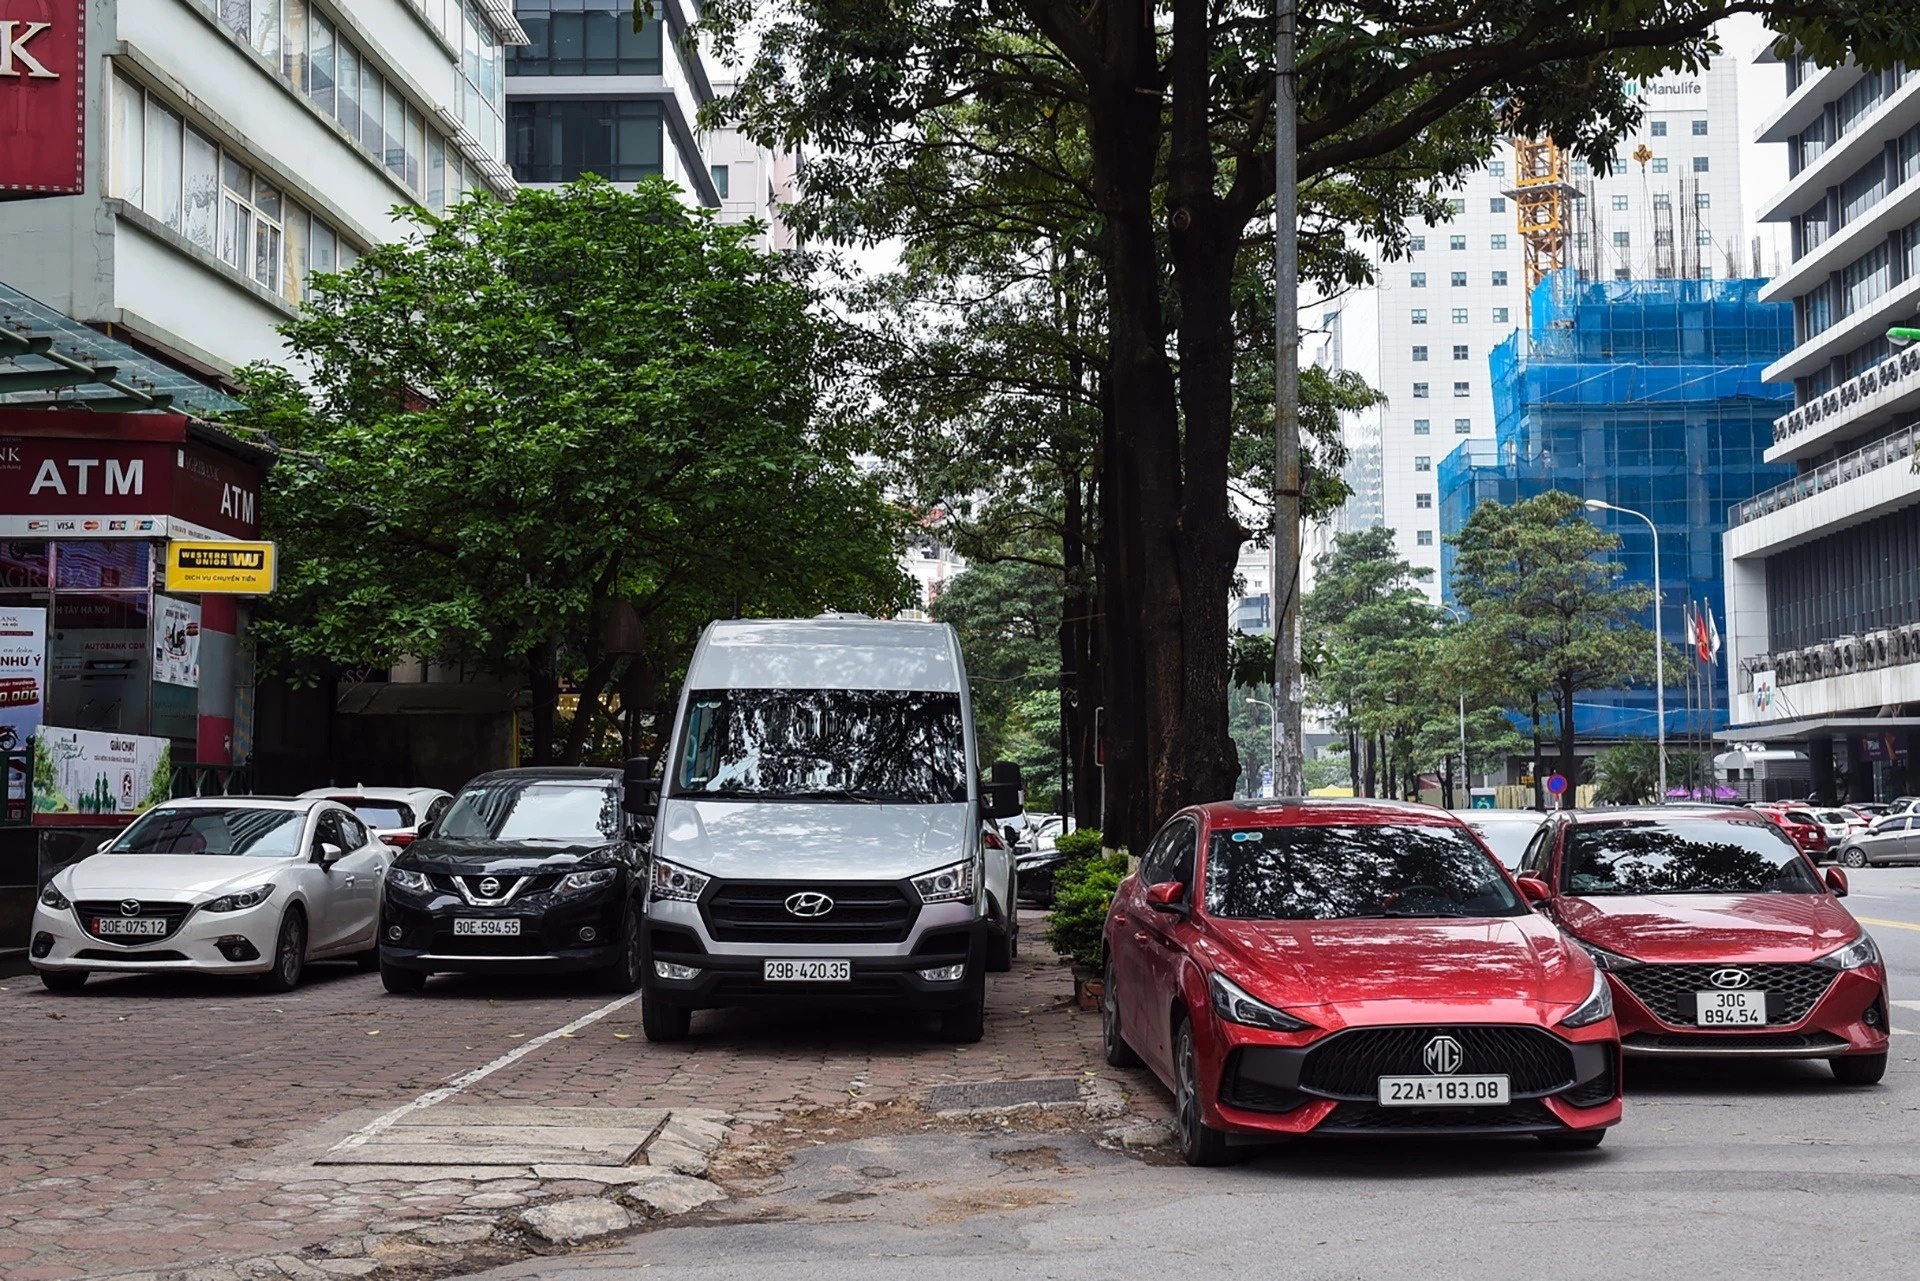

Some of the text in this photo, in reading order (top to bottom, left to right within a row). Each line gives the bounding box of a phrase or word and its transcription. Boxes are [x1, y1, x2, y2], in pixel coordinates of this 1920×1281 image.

[1645, 81, 1702, 95] Manulife
[28, 459, 144, 495] ATM
[220, 482, 254, 525] ATM
[57, 521, 75, 530] VISA
[181, 551, 228, 559] WESTERN
[195, 552, 259, 567] UNION WU
[84, 642, 127, 650] AUTOBANK
[101, 920, 165, 934] 30E-075.12
[455, 921, 519, 934] 30E-594.55
[766, 962, 848, 979] 29B-420.35
[1716, 993, 1746, 1008] 30G
[1705, 1009, 1758, 1023] 894.54
[1427, 1040, 1460, 1072] MG
[1390, 1081, 1499, 1100] 22A-183.08
